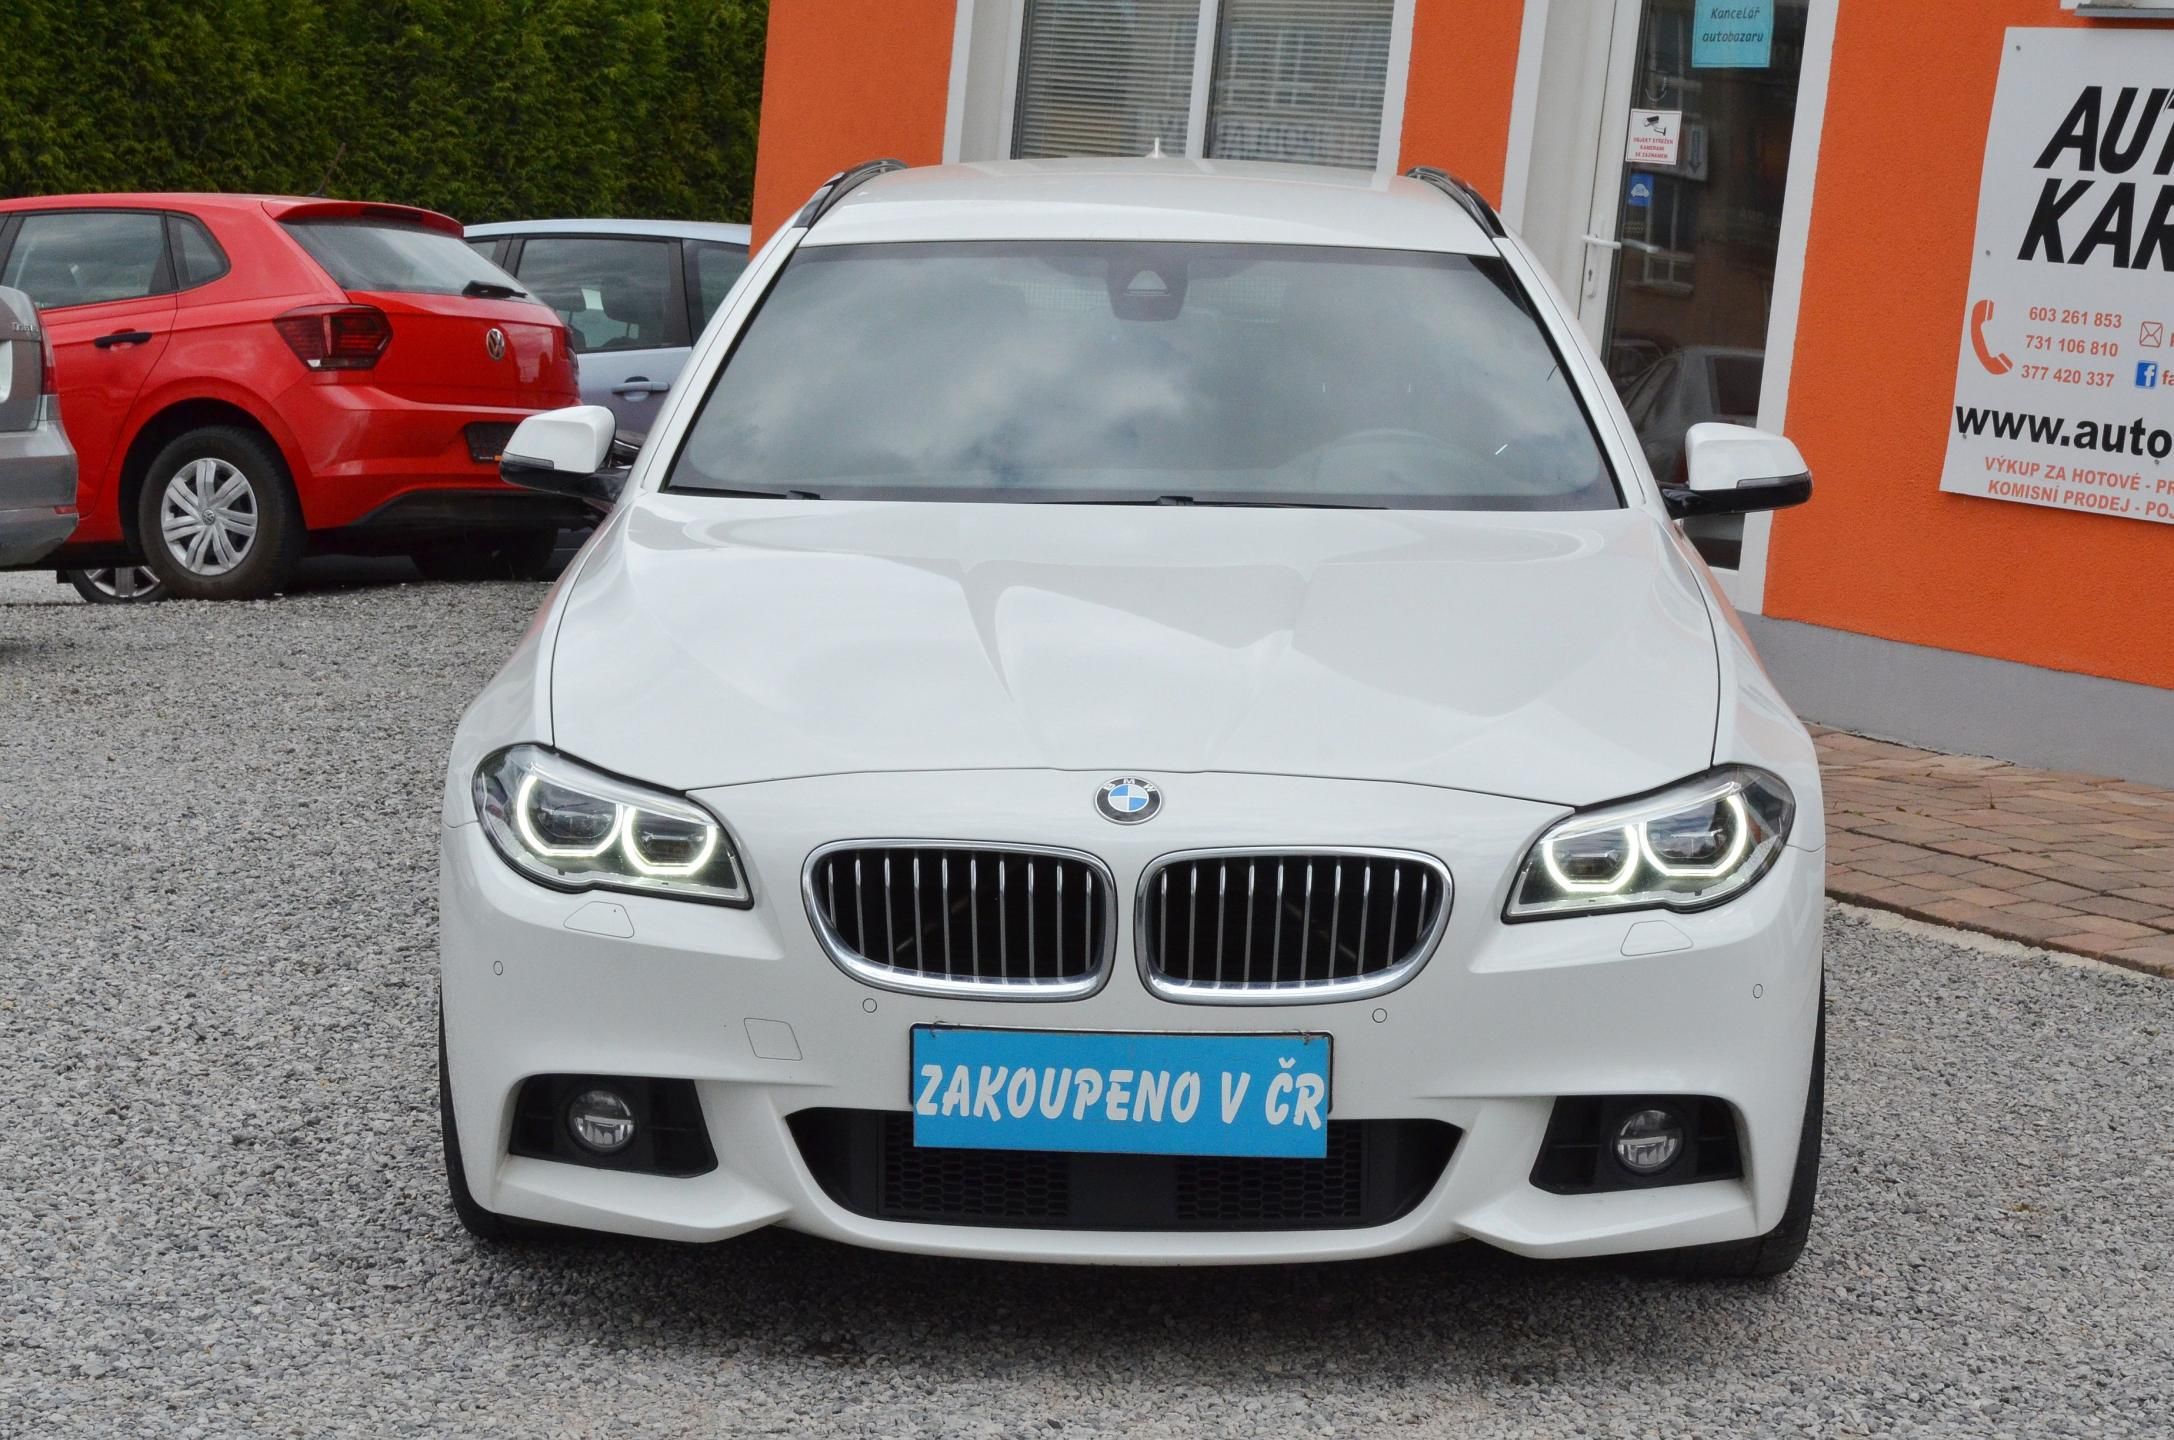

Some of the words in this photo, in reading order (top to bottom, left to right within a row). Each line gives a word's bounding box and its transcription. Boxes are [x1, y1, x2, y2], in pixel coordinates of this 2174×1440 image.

[1702, 31, 1764, 42] autobazaru
[2029, 306, 2057, 322] 603
[2061, 309, 2088, 326] 261
[2094, 312, 2122, 328] 853
[2025, 335, 2052, 350] 731
[2058, 338, 2085, 354] 106
[2090, 341, 2119, 357] 810
[2021, 365, 2049, 381] 377
[2053, 369, 2081, 384] 420
[2086, 371, 2115, 387] 337
[1985, 456, 2041, 476] VÝKUP
[2044, 464, 2067, 481] ZA
[2071, 468, 2142, 491] HOTOVÉ
[1988, 480, 2059, 502] KOMISNÍ
[2063, 490, 2131, 513] PRODEJ
[916, 1064, 1200, 1124] ZAKOUPENO
[1220, 1071, 1251, 1125] V
[1265, 1057, 1326, 1131] ČR
